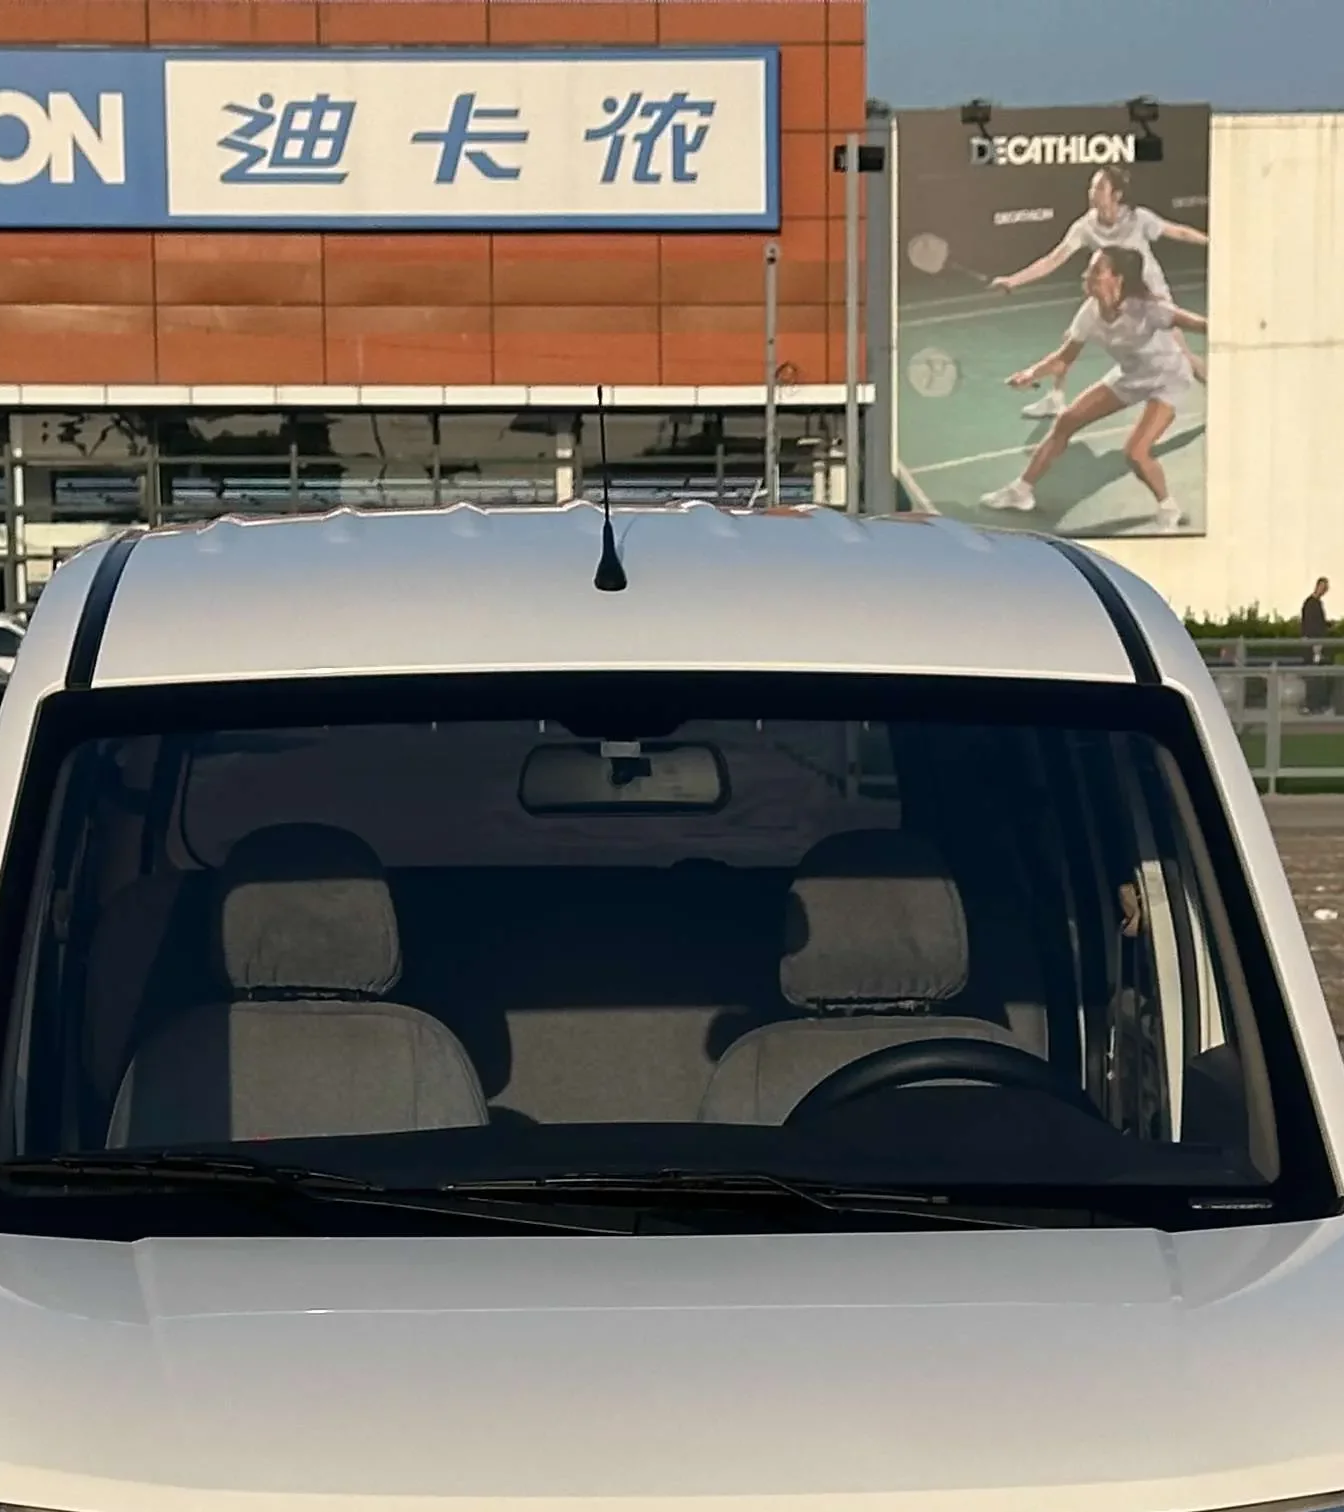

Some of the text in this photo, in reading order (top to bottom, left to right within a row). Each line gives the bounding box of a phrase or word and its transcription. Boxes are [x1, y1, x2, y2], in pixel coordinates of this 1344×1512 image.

[217, 92, 717, 184] 迪卡侬
[969, 133, 1136, 165] DECATHLON
